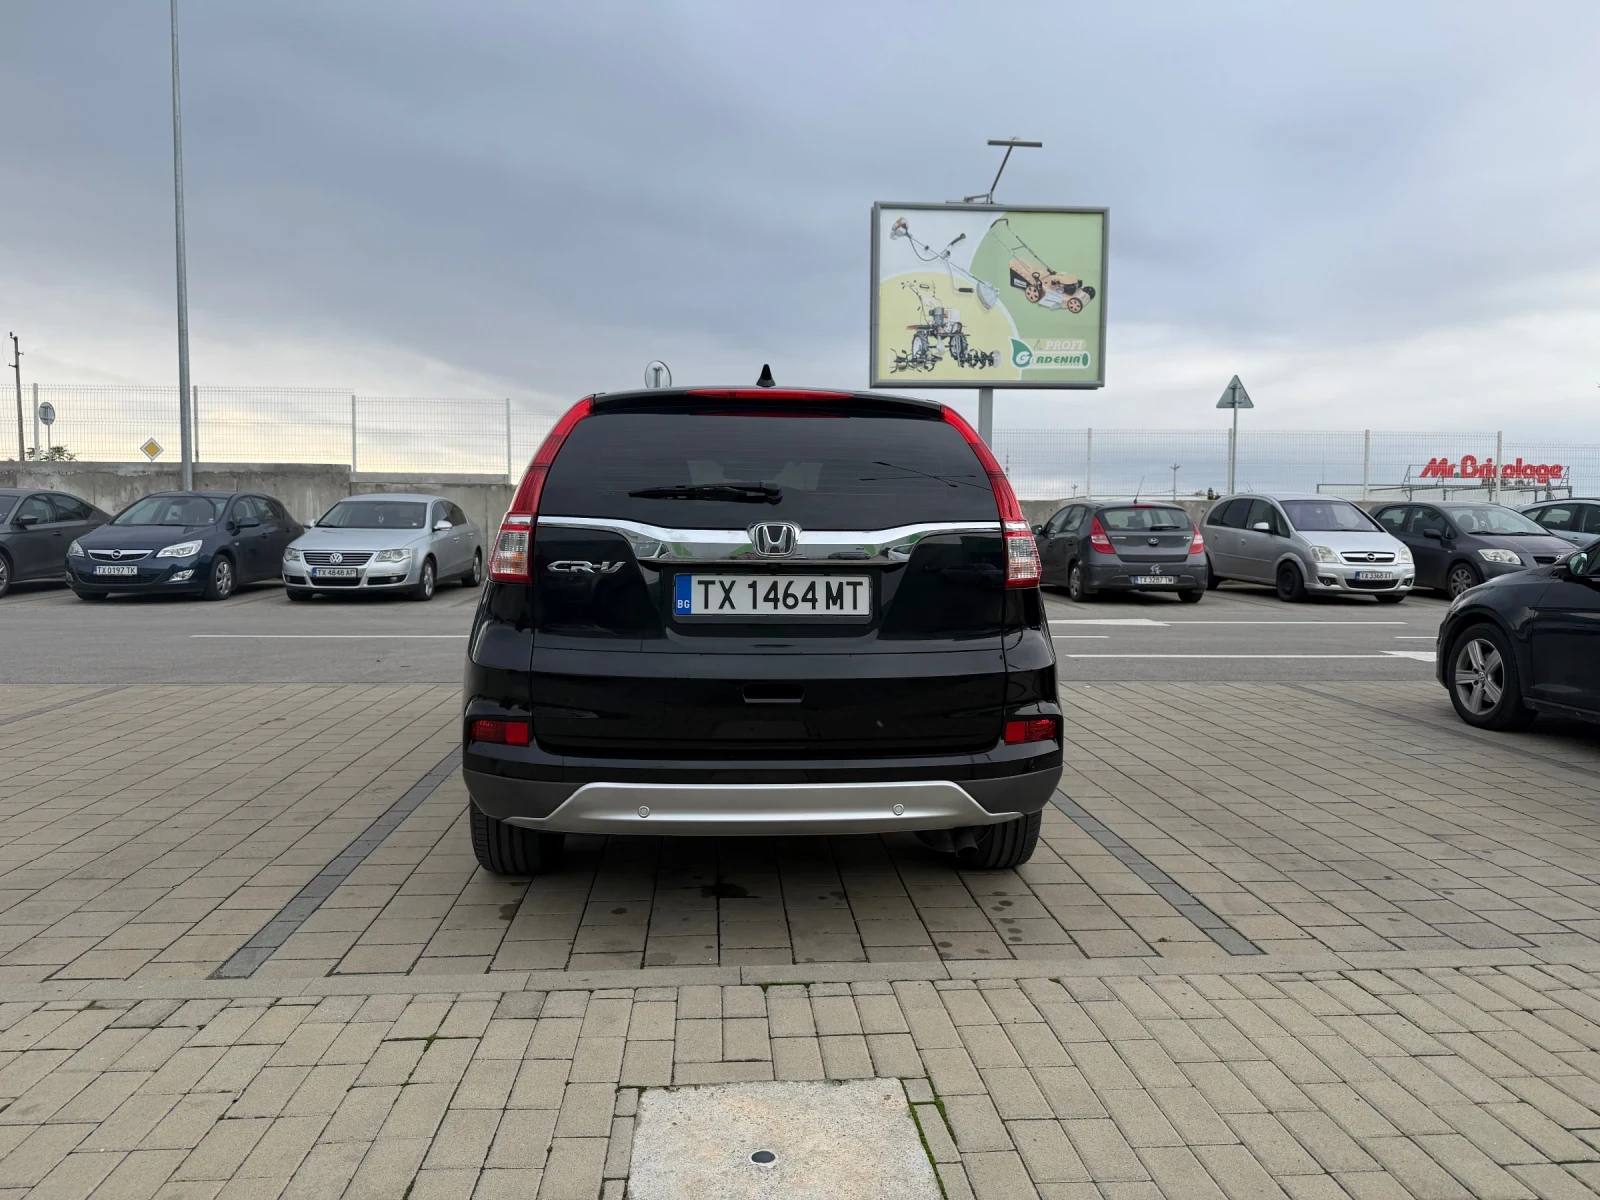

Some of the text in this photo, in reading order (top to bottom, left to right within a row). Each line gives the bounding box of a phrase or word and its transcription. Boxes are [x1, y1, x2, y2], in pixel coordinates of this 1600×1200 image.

[1044, 340, 1085, 351] PROFI
[97, 566, 107, 574] TX
[107, 566, 125, 574] 0197
[125, 566, 136, 574] TK
[546, 560, 626, 574] CR-V
[697, 580, 864, 610] TX 1464 MT
[677, 600, 690, 609] BG
